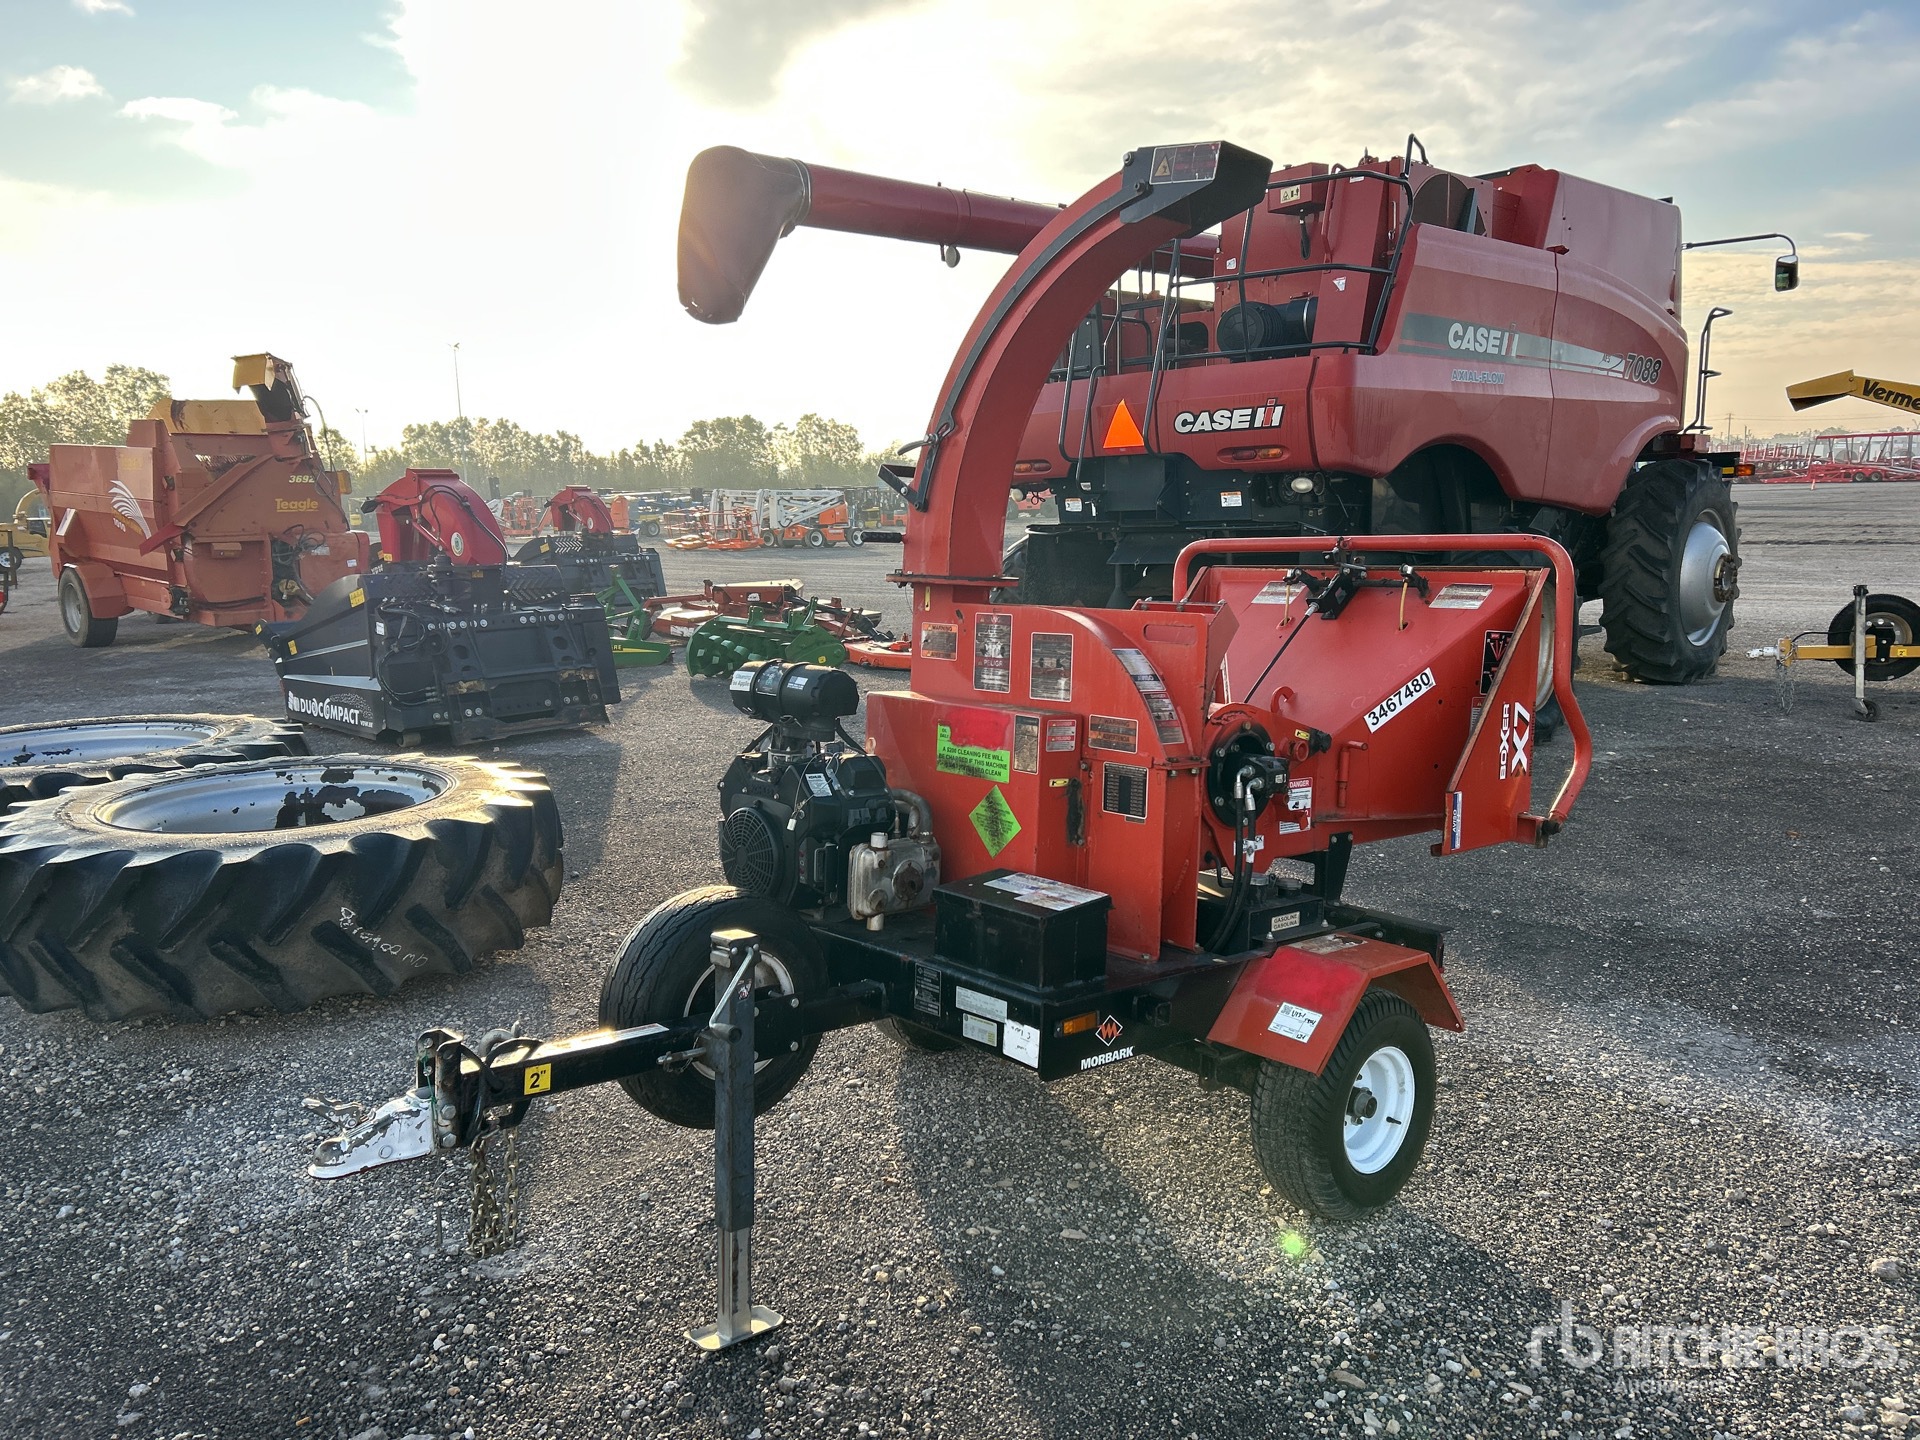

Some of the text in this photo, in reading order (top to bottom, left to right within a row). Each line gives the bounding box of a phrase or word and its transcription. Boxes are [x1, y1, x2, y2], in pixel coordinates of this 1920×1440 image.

[1448, 322, 1501, 353] CASE
[1451, 369, 1505, 385] AXIAL-FLOW
[1624, 353, 1663, 385] 7088
[1174, 408, 1253, 434] CASE
[275, 498, 319, 512] Teagle
[1368, 672, 1430, 726] 3467480
[1499, 702, 1510, 780] BOXER
[1511, 701, 1531, 777] X7
[958, 748, 981, 758] CLEANING
[982, 752, 991, 760] FEE
[992, 754, 1004, 762] WILL
[985, 761, 1008, 771] MACHINE
[1289, 779, 1310, 788] DANGER
[1273, 913, 1298, 924] GASOLINE
[1273, 919, 1298, 930] GASOLINA
[1080, 1046, 1134, 1070] MORBARK
